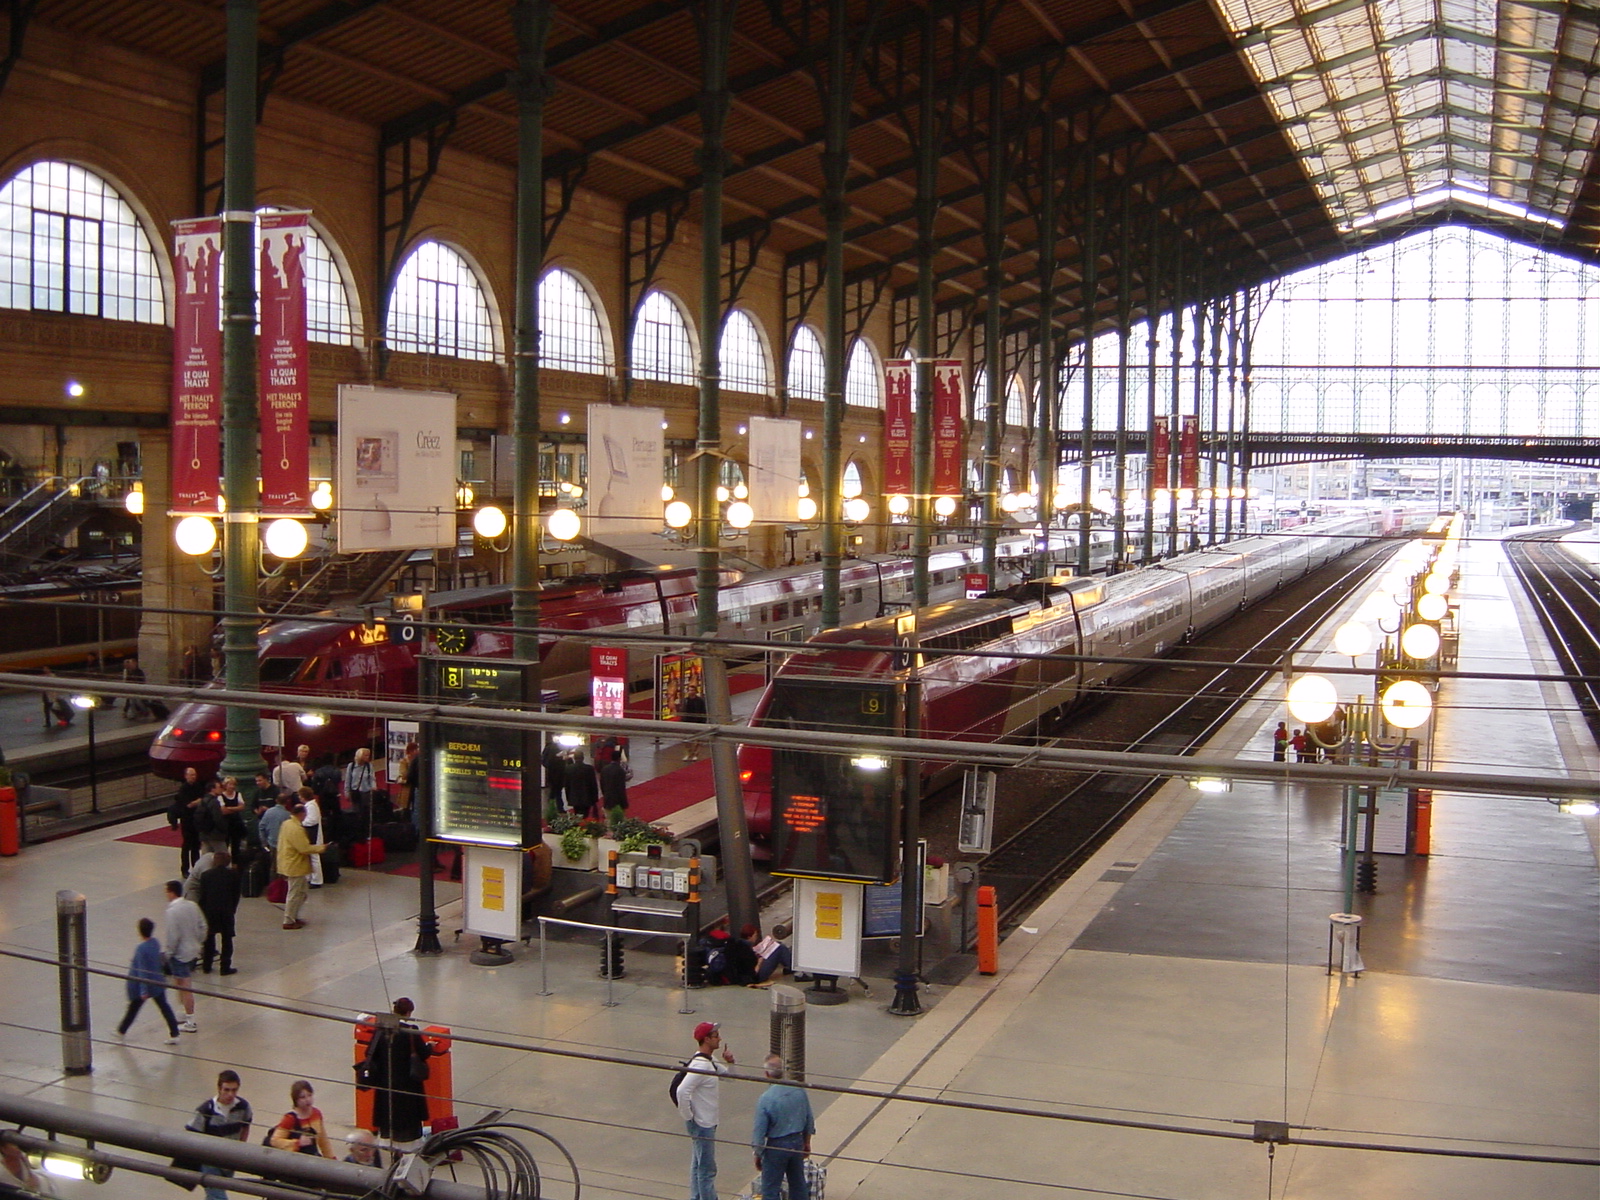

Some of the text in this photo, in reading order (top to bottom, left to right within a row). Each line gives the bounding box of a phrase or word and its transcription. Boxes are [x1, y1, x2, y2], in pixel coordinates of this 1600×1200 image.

[184, 379, 209, 387] THALYS
[270, 377, 296, 386] THALYS
[416, 430, 441, 449] Créez
[902, 636, 909, 666] 9
[448, 674, 456, 686] 8
[869, 698, 878, 713] 9
[448, 742, 481, 751] BERCHEM
